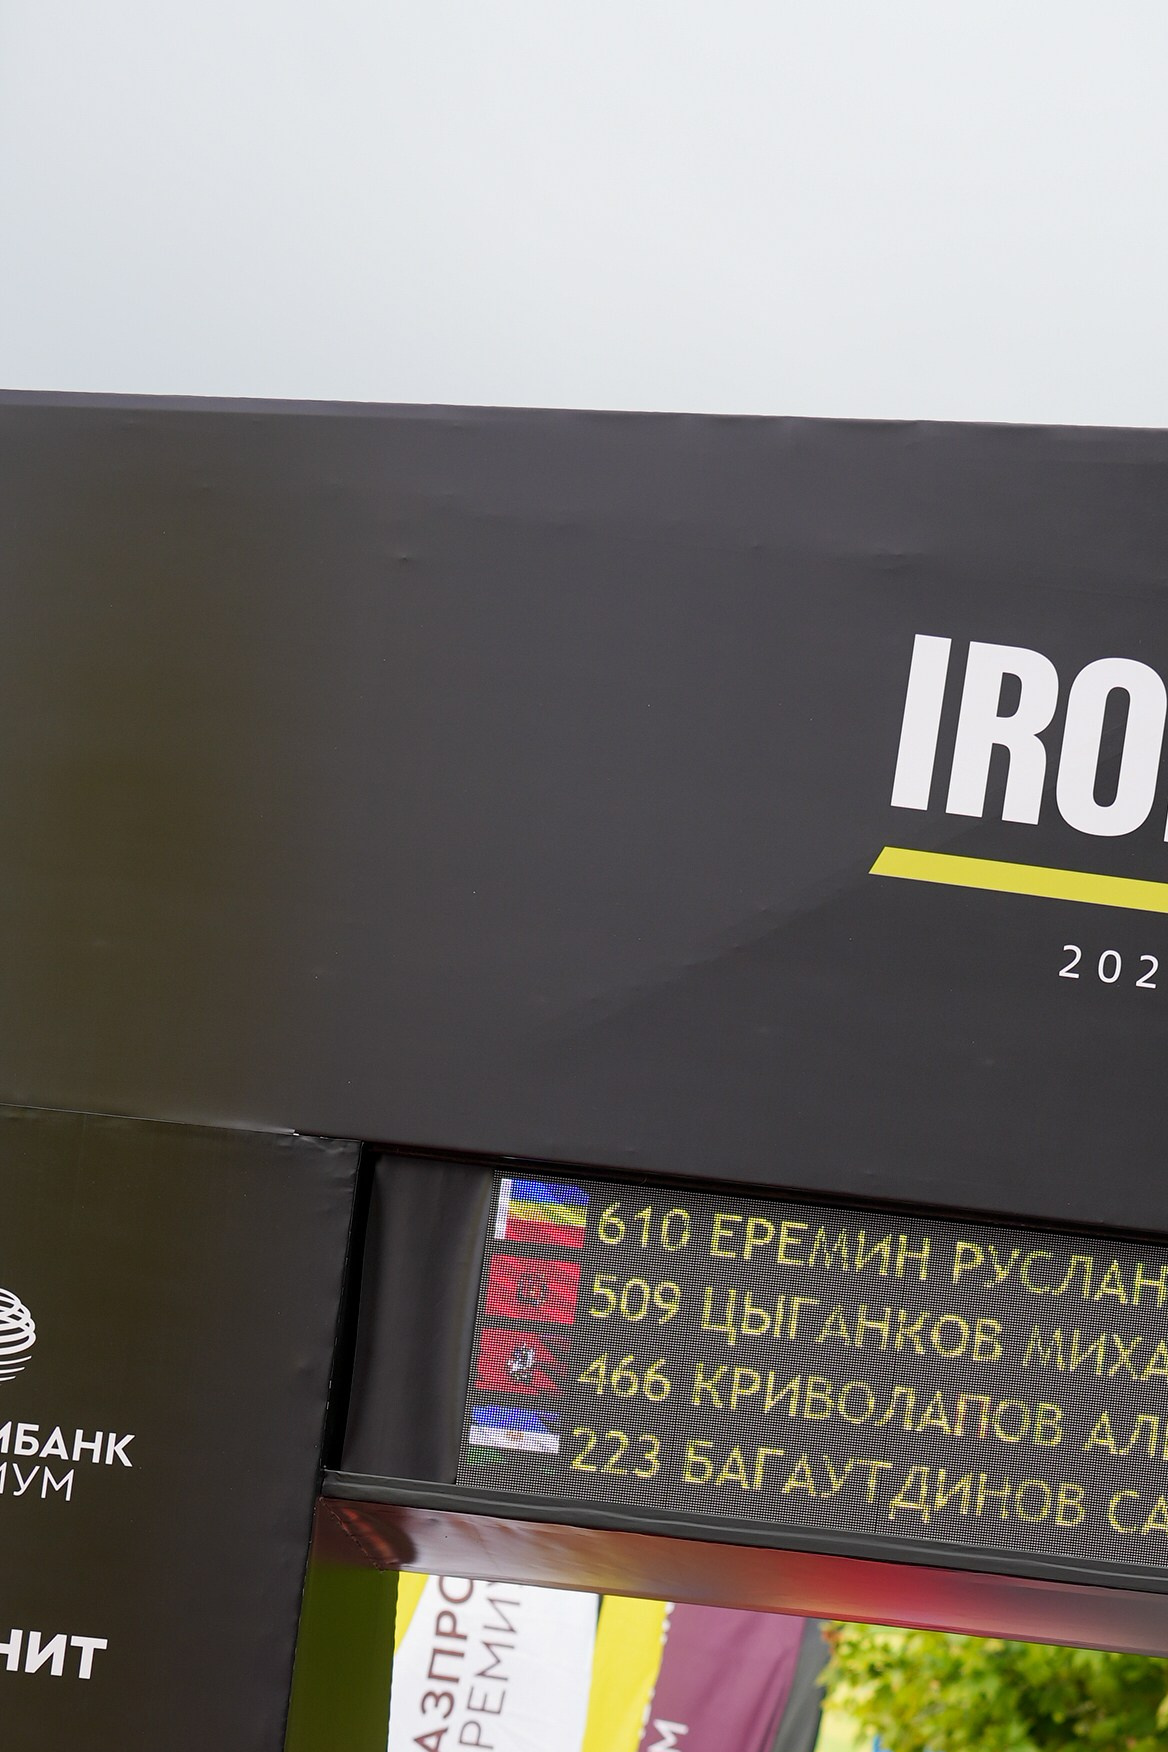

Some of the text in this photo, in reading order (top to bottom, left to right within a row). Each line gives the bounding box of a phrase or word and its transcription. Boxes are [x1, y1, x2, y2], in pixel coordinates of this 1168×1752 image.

[597, 1203, 690, 1252] 610
[710, 1211, 932, 1281] ЕРЕМИН
[588, 1272, 682, 1325] 509
[700, 1285, 1003, 1362] ЦЫГАНКОВ
[577, 1353, 672, 1402] 466
[691, 1361, 1064, 1447] КРИВОЛАПОВ
[0, 1461, 75, 1502] УМ
[570, 1426, 661, 1479] 223
[682, 1440, 1087, 1524] БАГАУТДИНОВ
